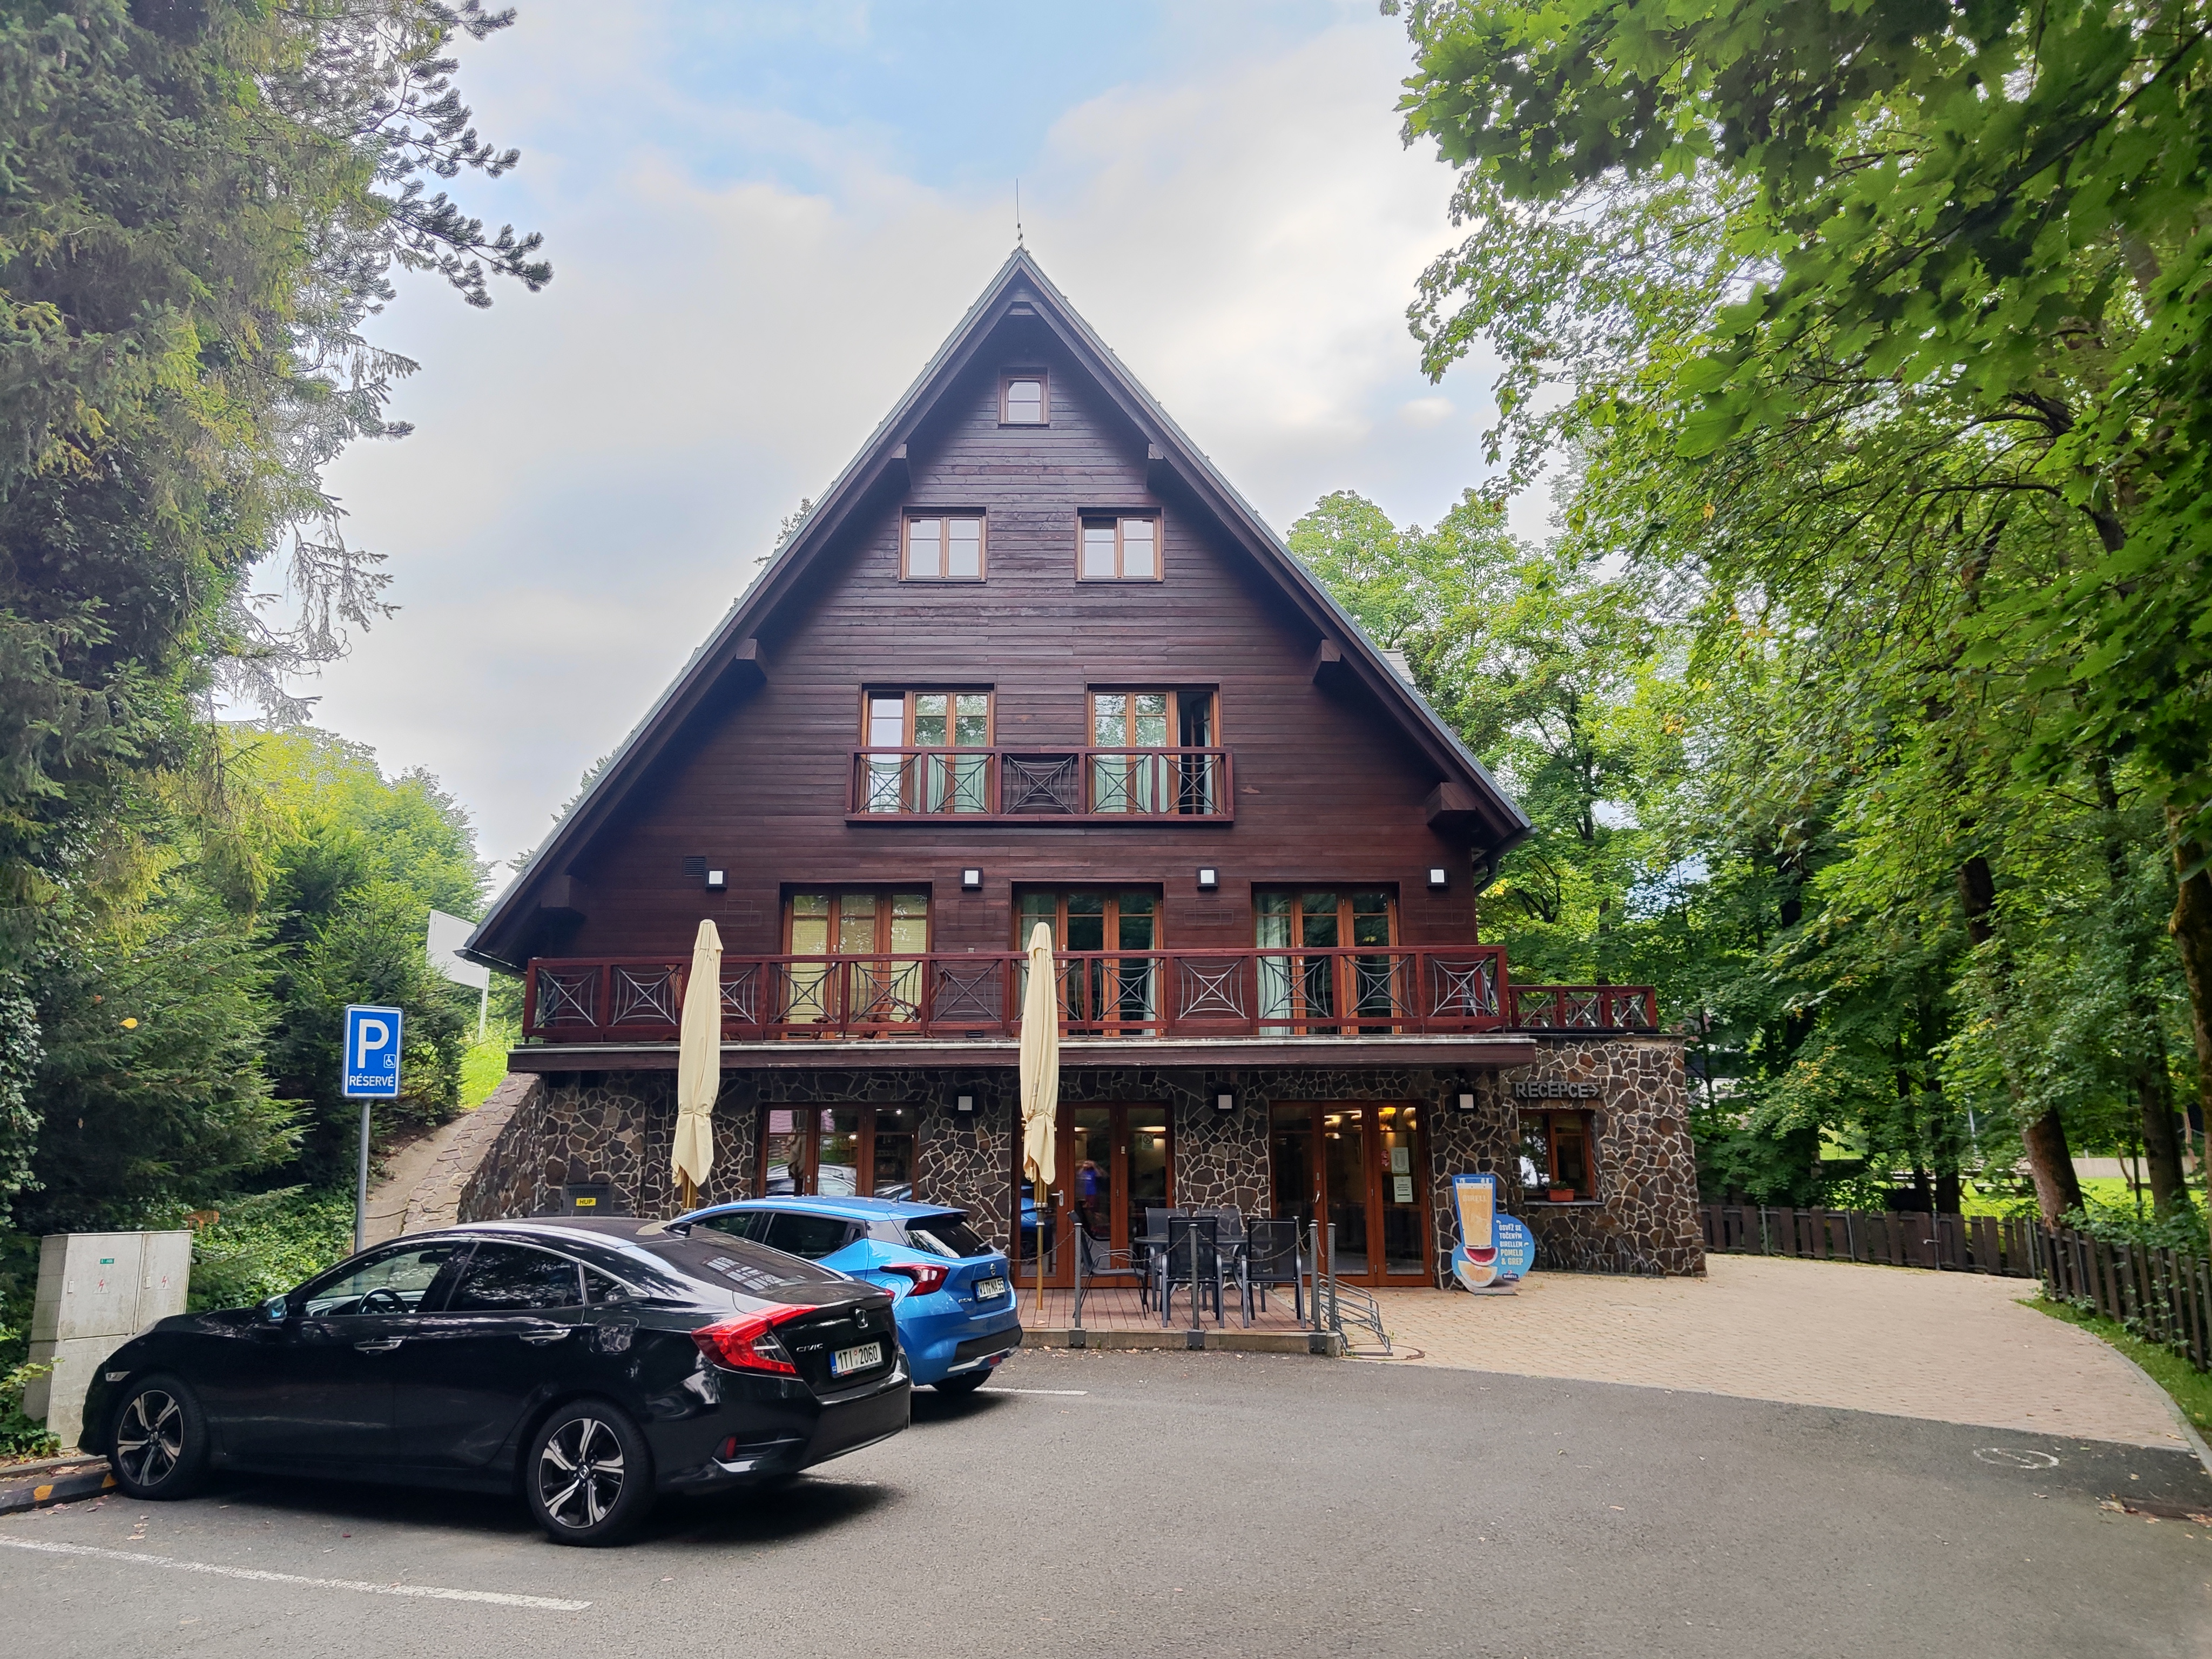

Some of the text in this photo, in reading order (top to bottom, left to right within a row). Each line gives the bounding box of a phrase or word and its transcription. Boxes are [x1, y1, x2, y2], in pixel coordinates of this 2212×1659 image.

[358, 1019, 389, 1069] P
[349, 1073, 395, 1087] RÉSERVÉ
[1515, 1082, 1589, 1098] RECEPCE
[1500, 1249, 1523, 1257] POMELO
[796, 1343, 823, 1352] CIVIC
[838, 1345, 878, 1370] 1TI 2060
